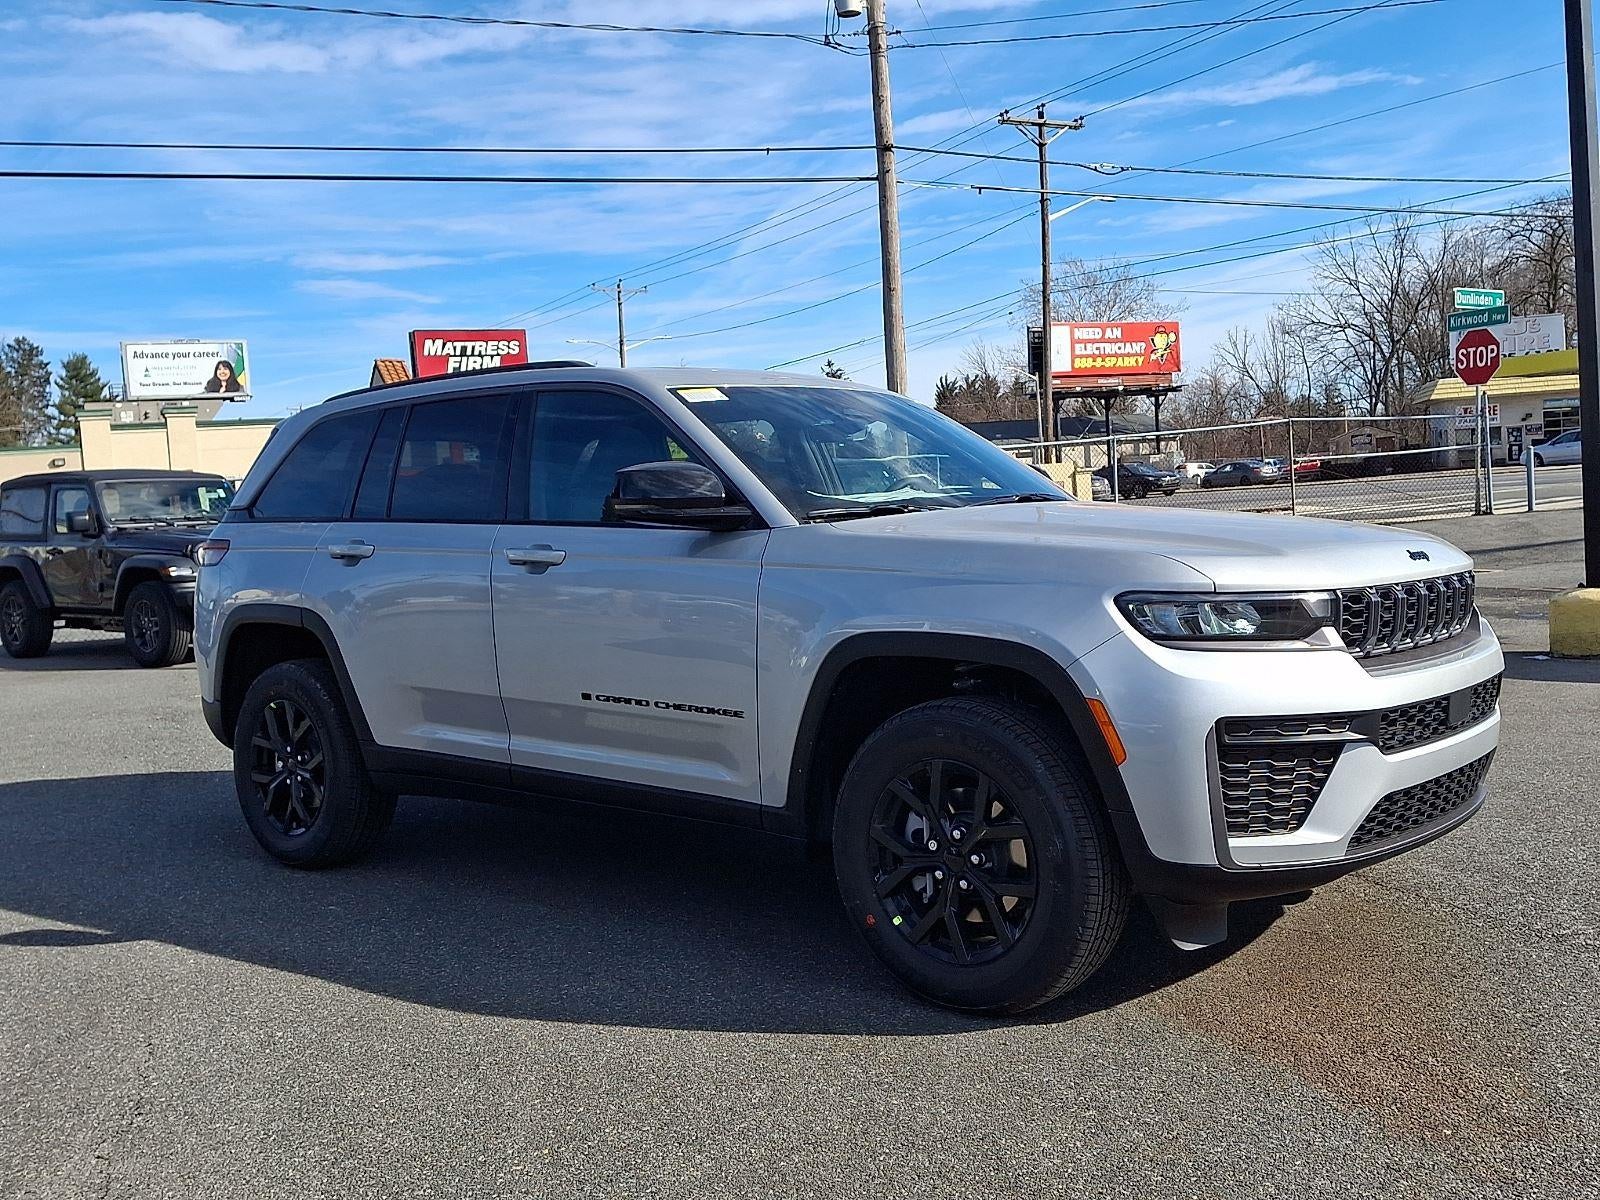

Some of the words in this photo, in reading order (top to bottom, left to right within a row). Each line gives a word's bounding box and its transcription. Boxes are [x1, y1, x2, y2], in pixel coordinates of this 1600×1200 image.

[1457, 291, 1493, 306] Dunlinden
[1450, 311, 1489, 328] Kirkwood
[1492, 313, 1506, 321] Hwy
[1074, 327, 1103, 339] NEED
[1104, 327, 1122, 339] AN
[133, 350, 170, 360] Advance
[171, 351, 191, 361] your
[192, 351, 222, 359] career.
[1074, 341, 1147, 355] ELECTRICIAN?
[447, 355, 501, 374] FIRM
[1074, 355, 1145, 369] 888-8-SPARKY
[1457, 345, 1498, 370] STOP
[595, 694, 650, 707] GRAND
[653, 700, 746, 719] CHEROKEE
